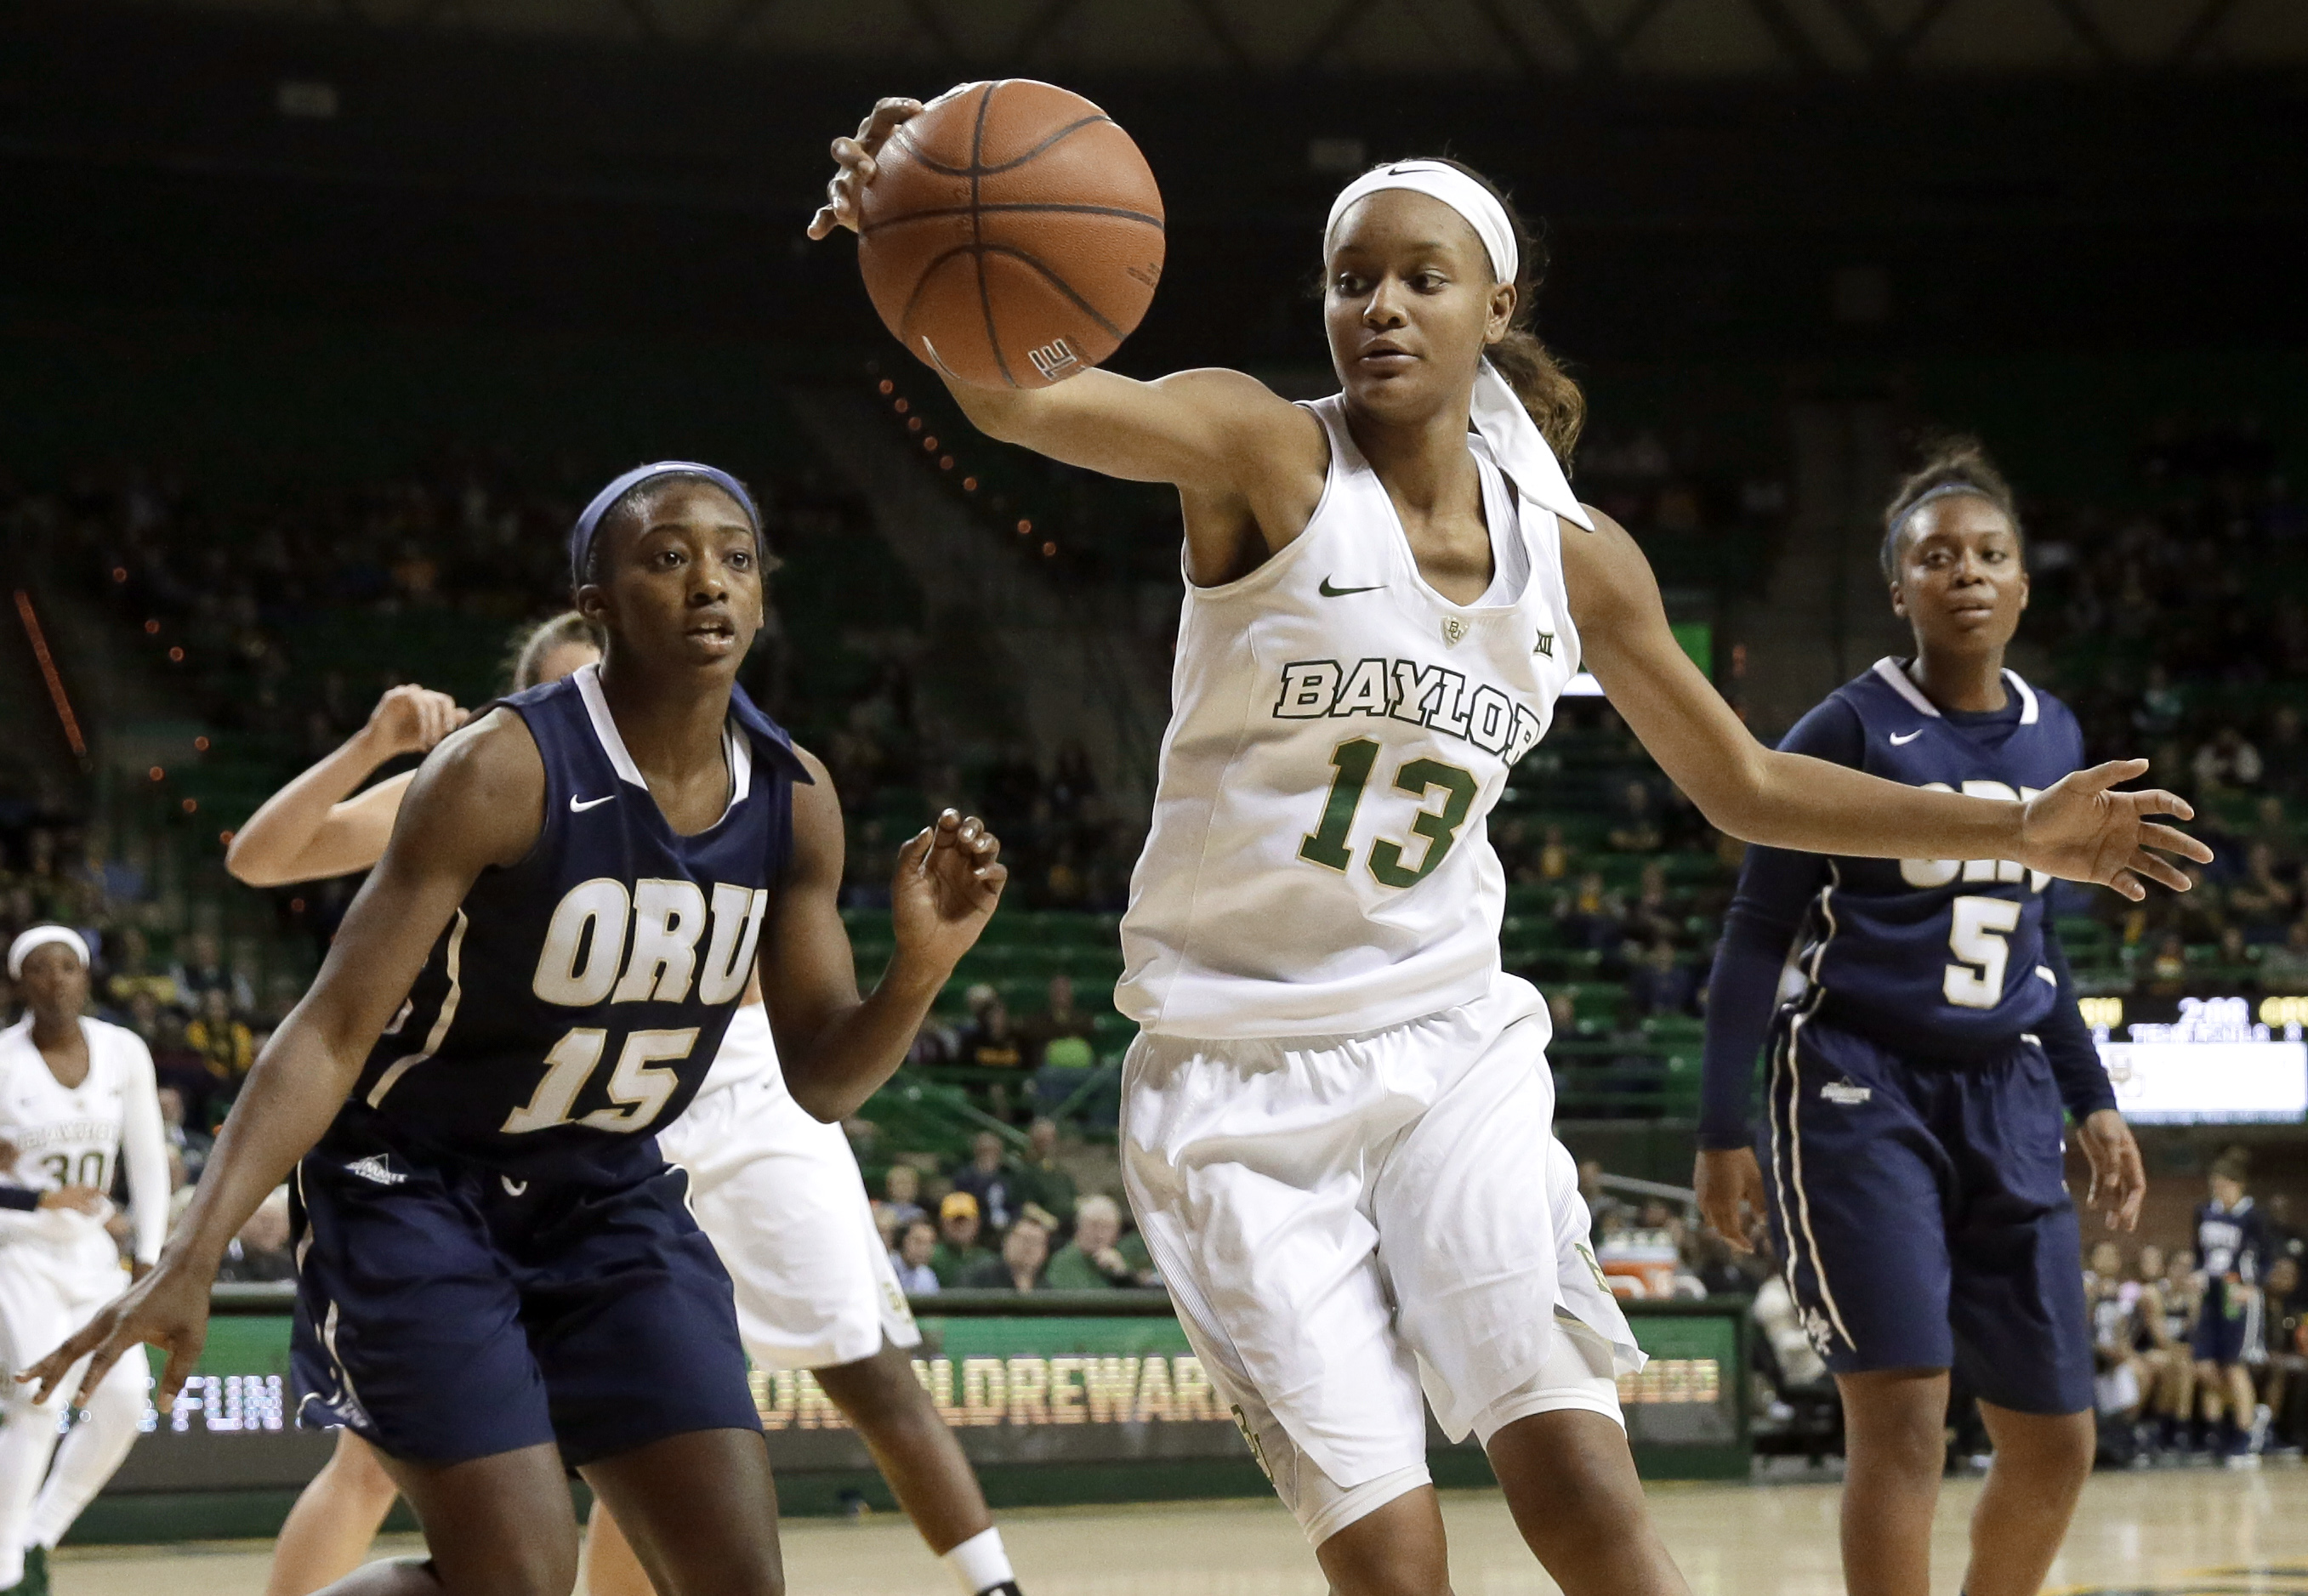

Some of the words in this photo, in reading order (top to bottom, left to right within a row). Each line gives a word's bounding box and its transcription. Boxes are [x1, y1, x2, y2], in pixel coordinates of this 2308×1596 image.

[1297, 738, 1477, 888] 13
[532, 878, 768, 1007] ORU
[1942, 895, 2022, 1009] 5
[498, 1027, 701, 1134] 15
[172, 1375, 283, 1432] FUN
